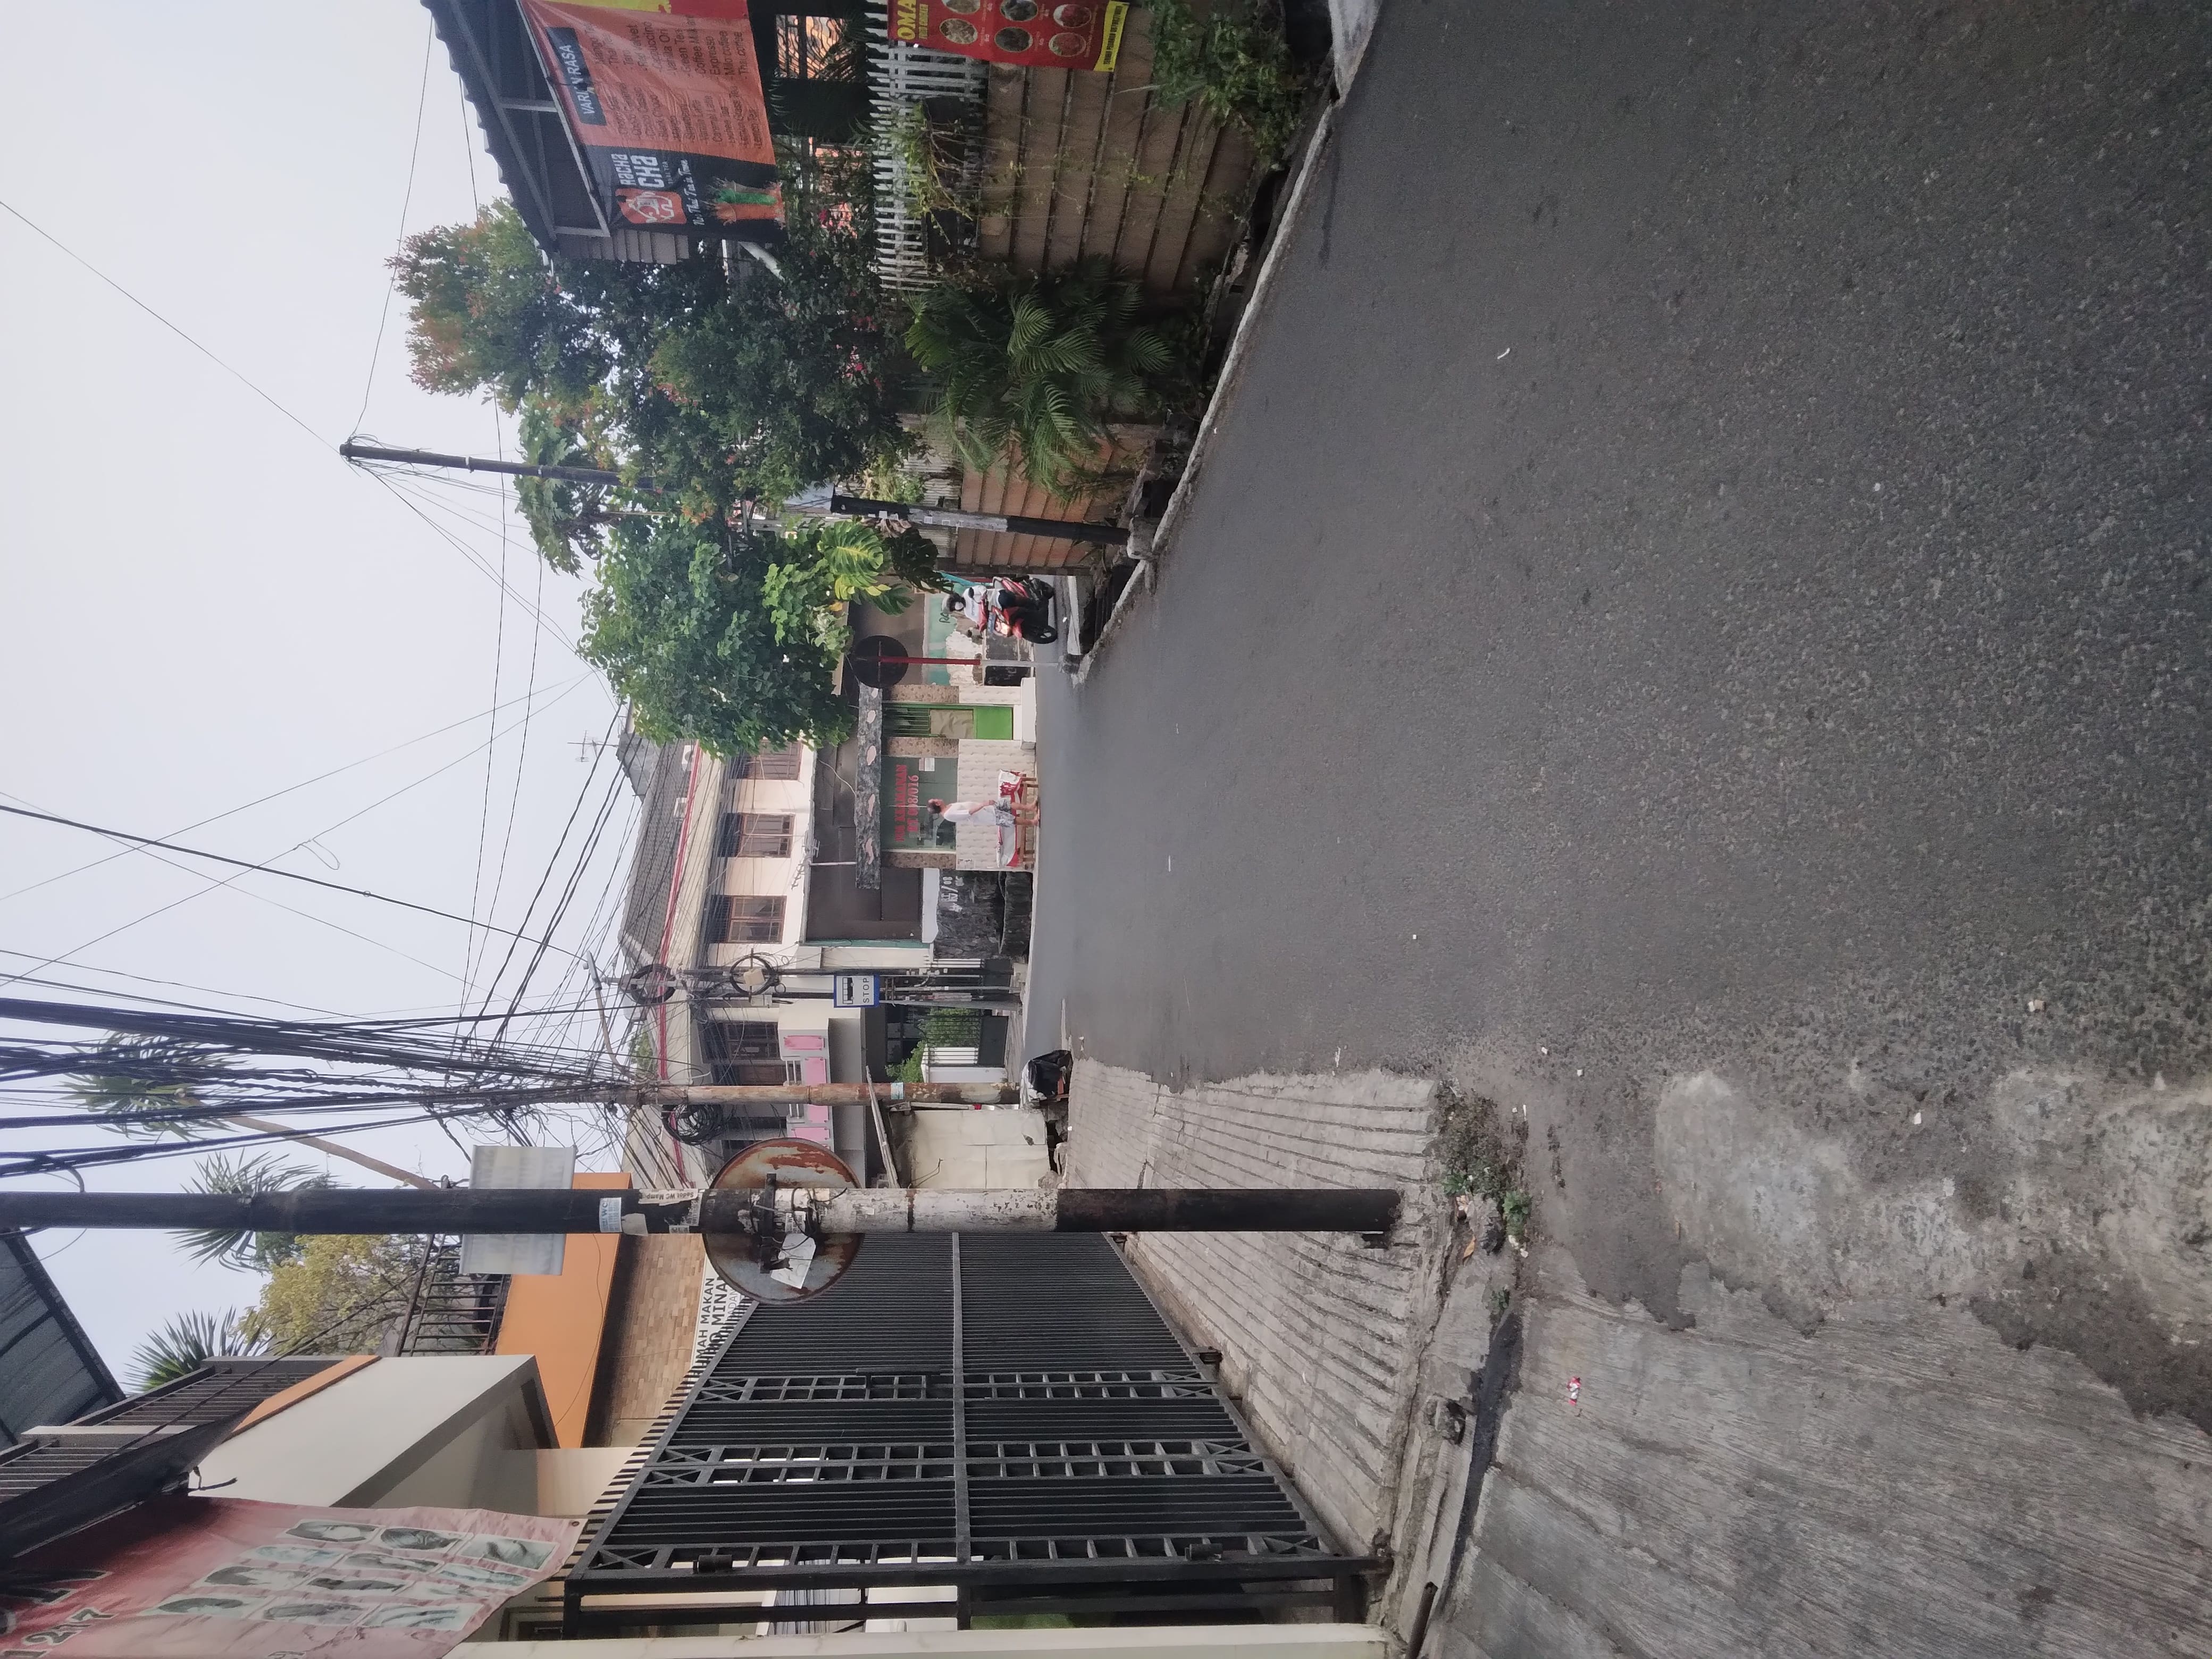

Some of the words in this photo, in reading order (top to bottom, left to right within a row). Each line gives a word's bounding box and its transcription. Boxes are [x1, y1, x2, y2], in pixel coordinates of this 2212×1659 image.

[674, 28, 685, 45] Tea
[558, 44, 582, 75] RASA
[678, 47, 691, 73] Green
[692, 45, 707, 74] Coffee
[705, 36, 722, 76] Expresso
[570, 77, 596, 114] VARIN
[602, 1202, 608, 1217] WC
[700, 1278, 715, 1324] MAKAN
[711, 1275, 728, 1326] MINA
